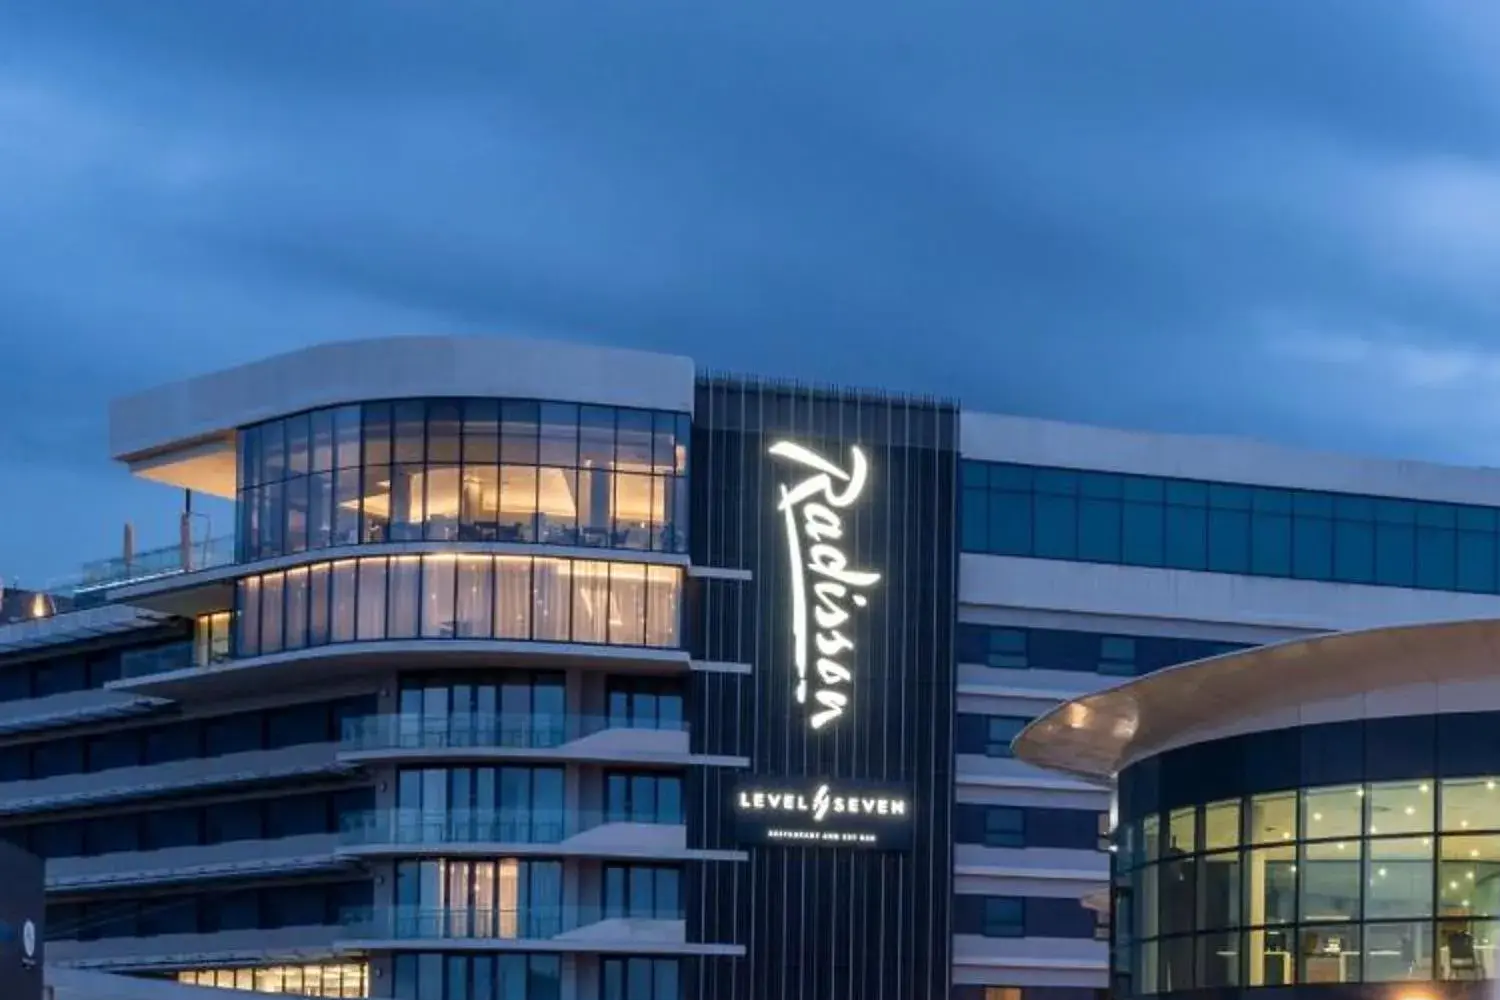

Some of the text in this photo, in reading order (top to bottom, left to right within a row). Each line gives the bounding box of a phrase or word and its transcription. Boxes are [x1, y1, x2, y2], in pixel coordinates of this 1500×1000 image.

[768, 440, 881, 729] Radisson
[739, 791, 906, 815] LEVEL SEVEN
